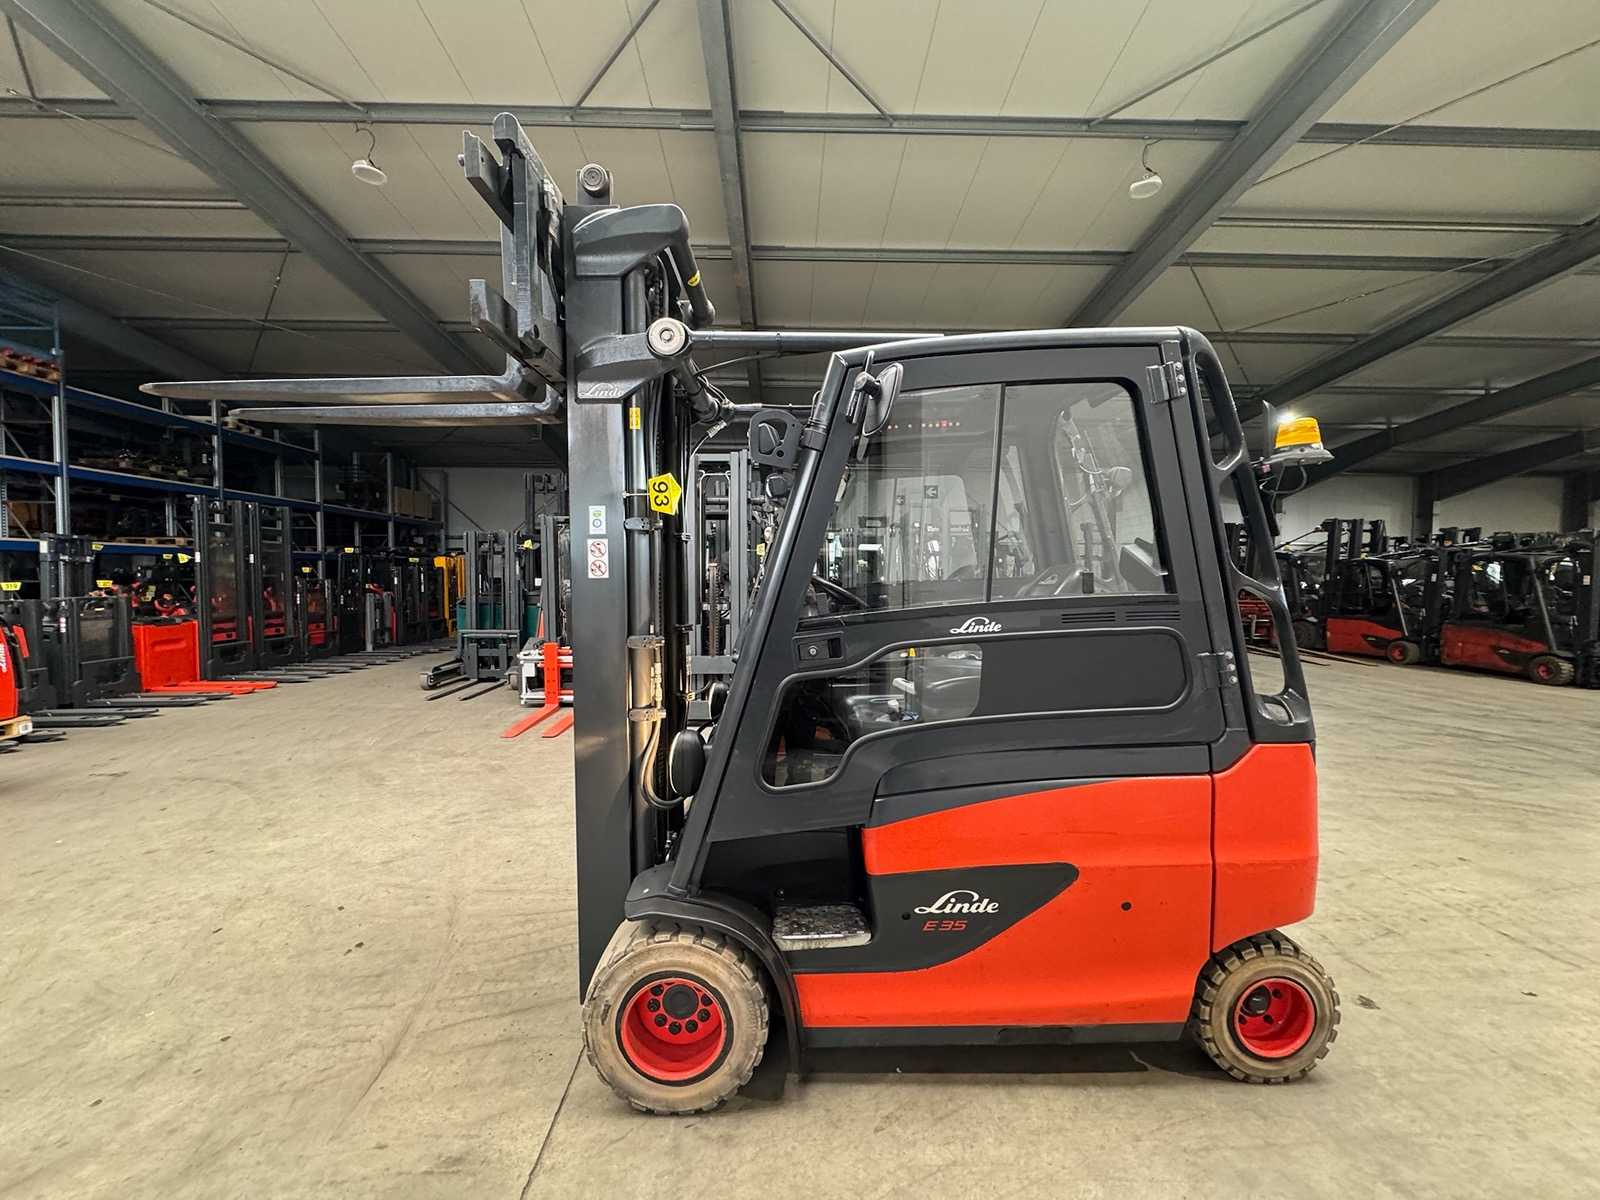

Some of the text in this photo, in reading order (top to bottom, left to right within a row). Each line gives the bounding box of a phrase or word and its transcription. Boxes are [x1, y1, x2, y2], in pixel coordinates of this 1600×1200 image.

[652, 481, 669, 506] 93
[950, 616, 1001, 634] Linde
[914, 889, 999, 914] Linde
